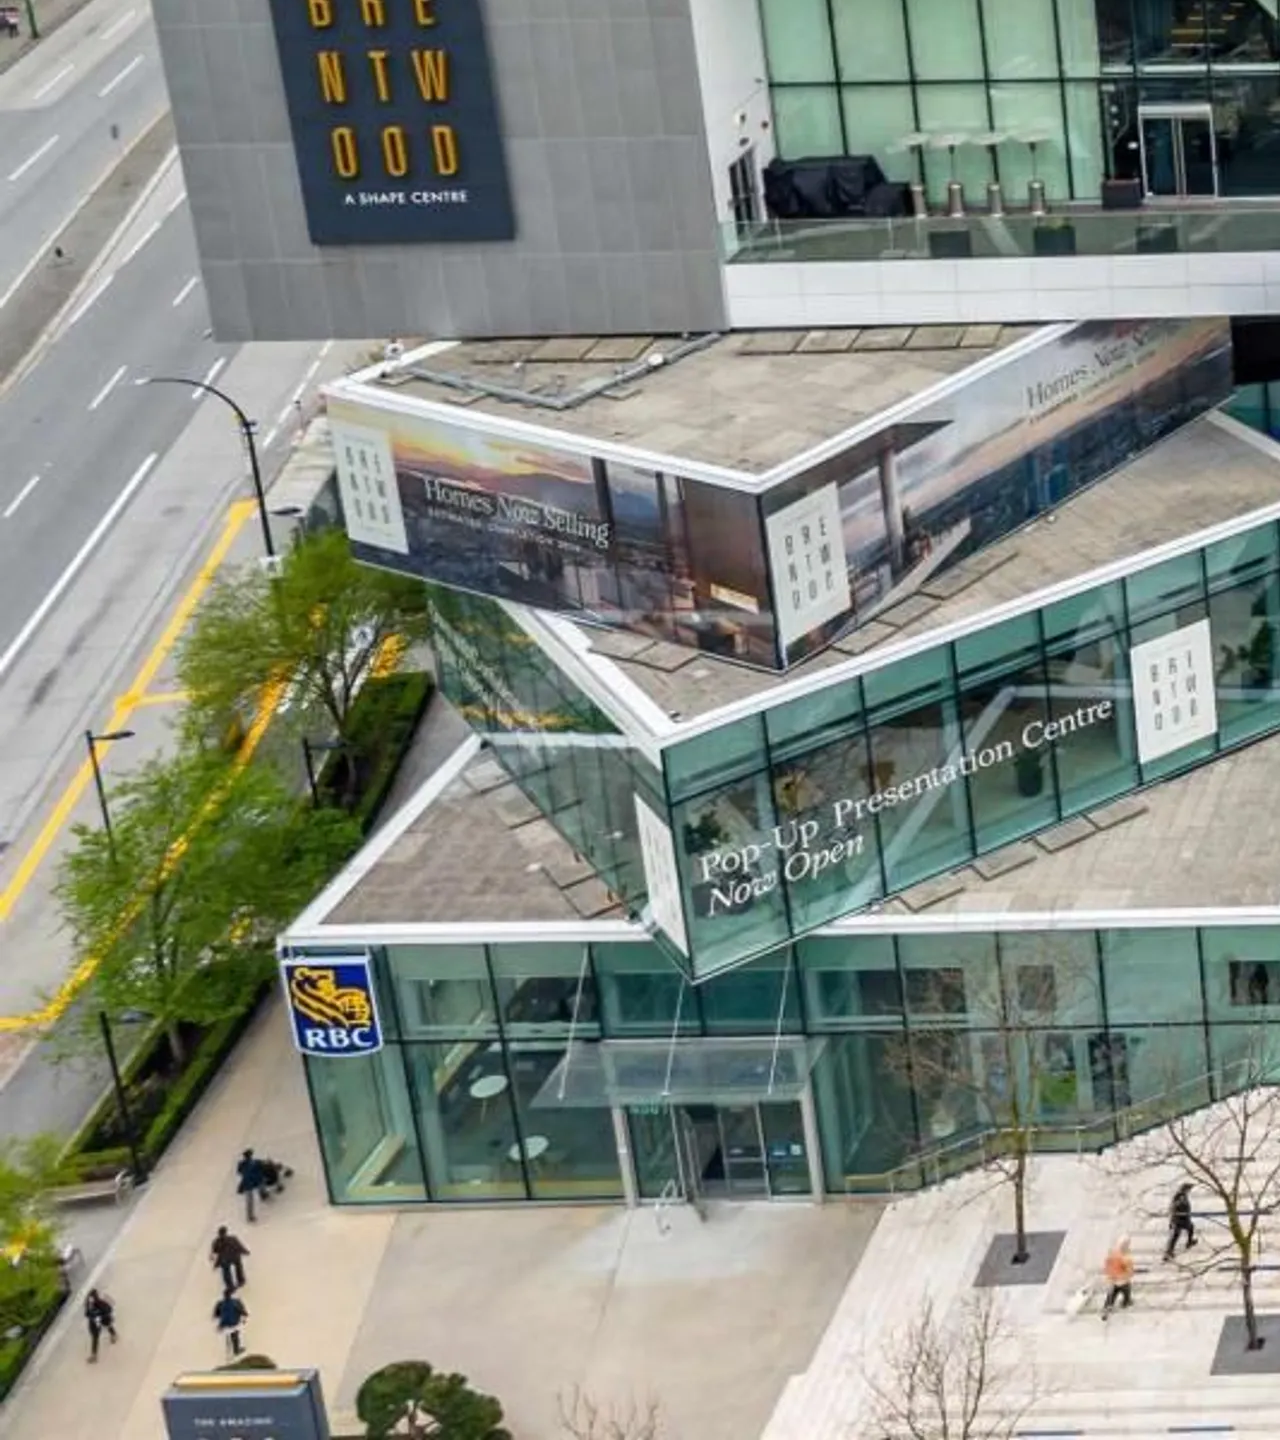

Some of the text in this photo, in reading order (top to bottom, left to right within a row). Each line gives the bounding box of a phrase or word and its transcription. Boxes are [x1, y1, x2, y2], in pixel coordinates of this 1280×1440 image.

[345, 189, 468, 205] A SHAPE CENTRE
[1026, 364, 1089, 409] Homes
[424, 476, 610, 549] Homes Now Selling
[700, 818, 820, 883] Pop-Up
[833, 742, 1014, 828] Presentation
[1021, 698, 1114, 750] Centre
[706, 870, 778, 918] Now
[783, 833, 866, 882] Open
[304, 1028, 373, 1048] RBC
